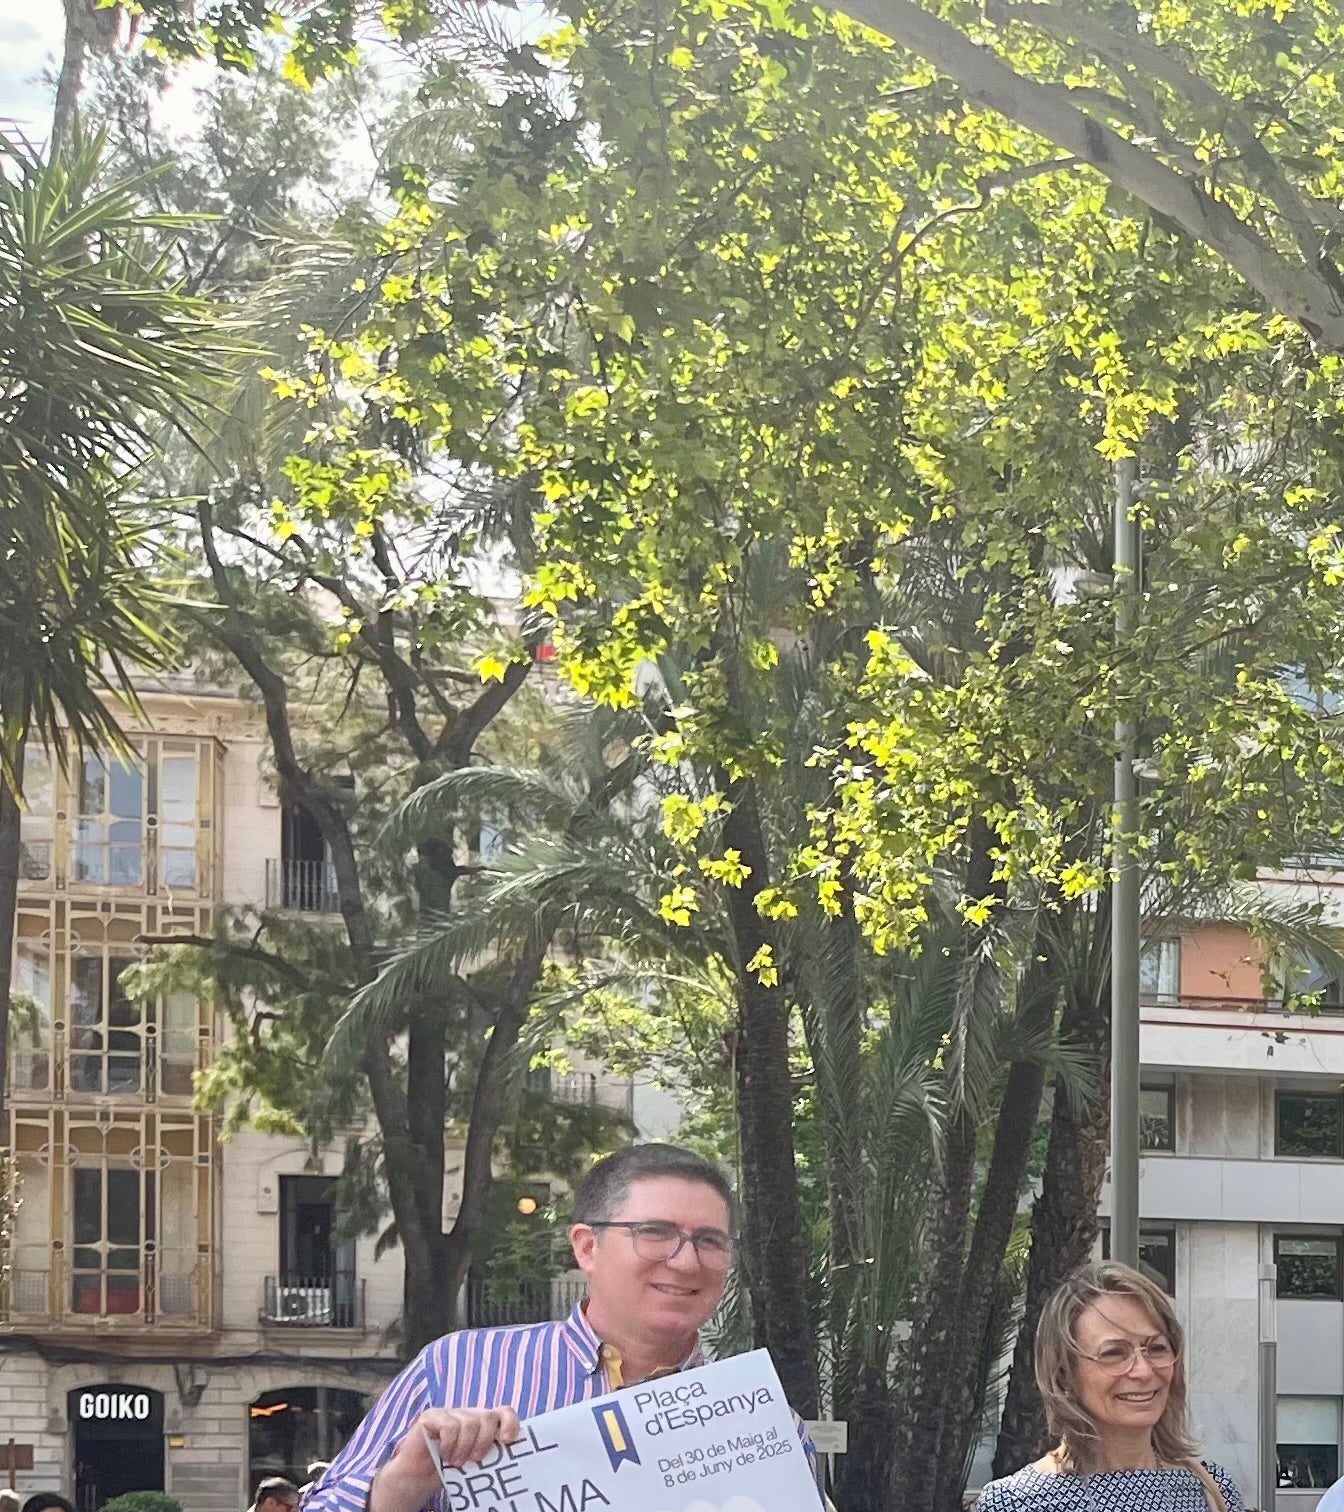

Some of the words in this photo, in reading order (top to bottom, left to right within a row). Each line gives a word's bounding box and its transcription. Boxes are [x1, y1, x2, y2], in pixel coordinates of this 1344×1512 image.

[79, 1393, 150, 1419] GOIKO
[633, 1381, 707, 1414] Plaça
[645, 1387, 774, 1436] d'Espanya
[657, 1455, 684, 1473] Del
[685, 1449, 705, 1466] 30
[706, 1443, 726, 1458] de
[727, 1431, 764, 1453] Maig
[765, 1426, 778, 1442] al
[664, 1474, 675, 1489] 8
[676, 1469, 697, 1485] de
[699, 1457, 734, 1479] Juny
[736, 1451, 756, 1467] de
[756, 1440, 793, 1461] 2025
[446, 1462, 528, 1511] BRE
